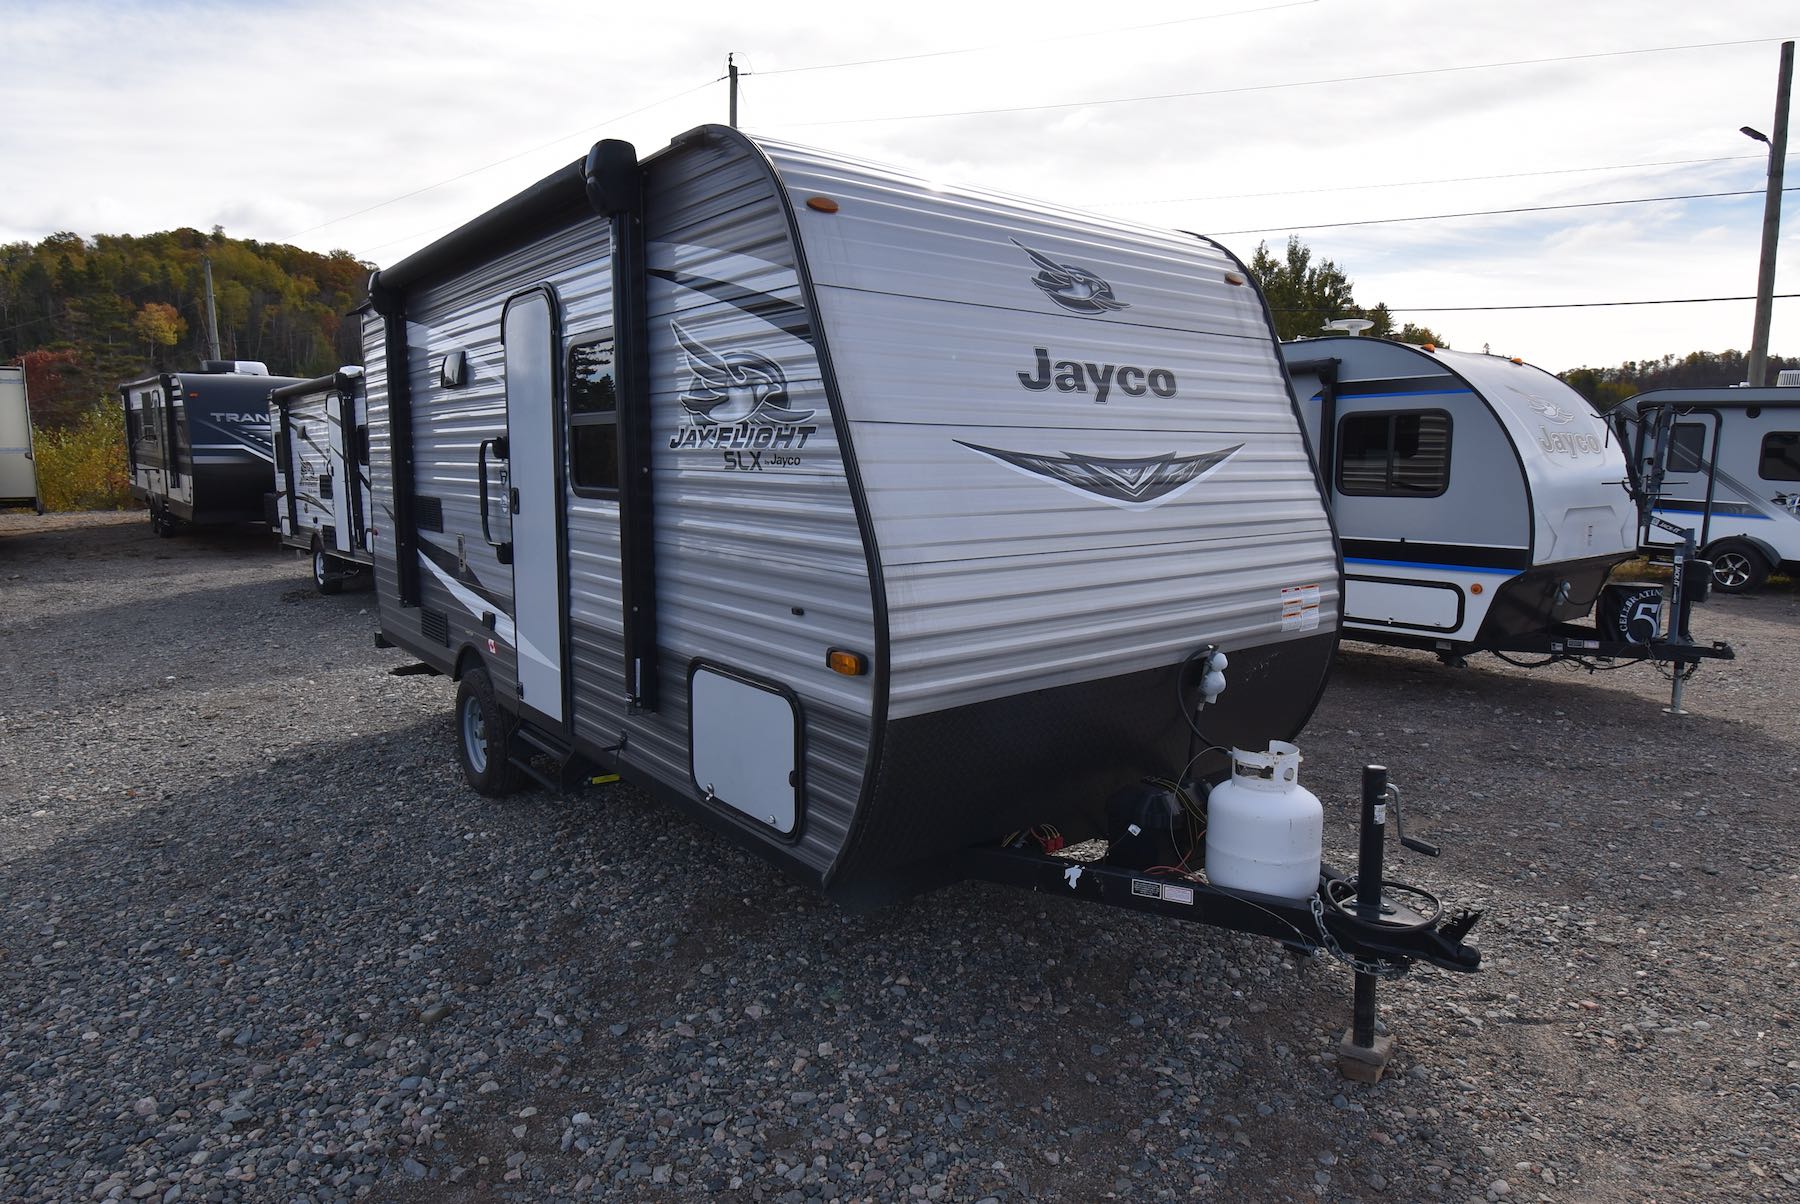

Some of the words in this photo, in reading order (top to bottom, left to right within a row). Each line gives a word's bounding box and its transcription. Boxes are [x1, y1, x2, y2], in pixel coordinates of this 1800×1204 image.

[1016, 345, 1178, 405] Jayco
[1539, 425, 1601, 458] Jayco
[723, 451, 763, 471] SLX
[770, 453, 801, 468] Jayco
